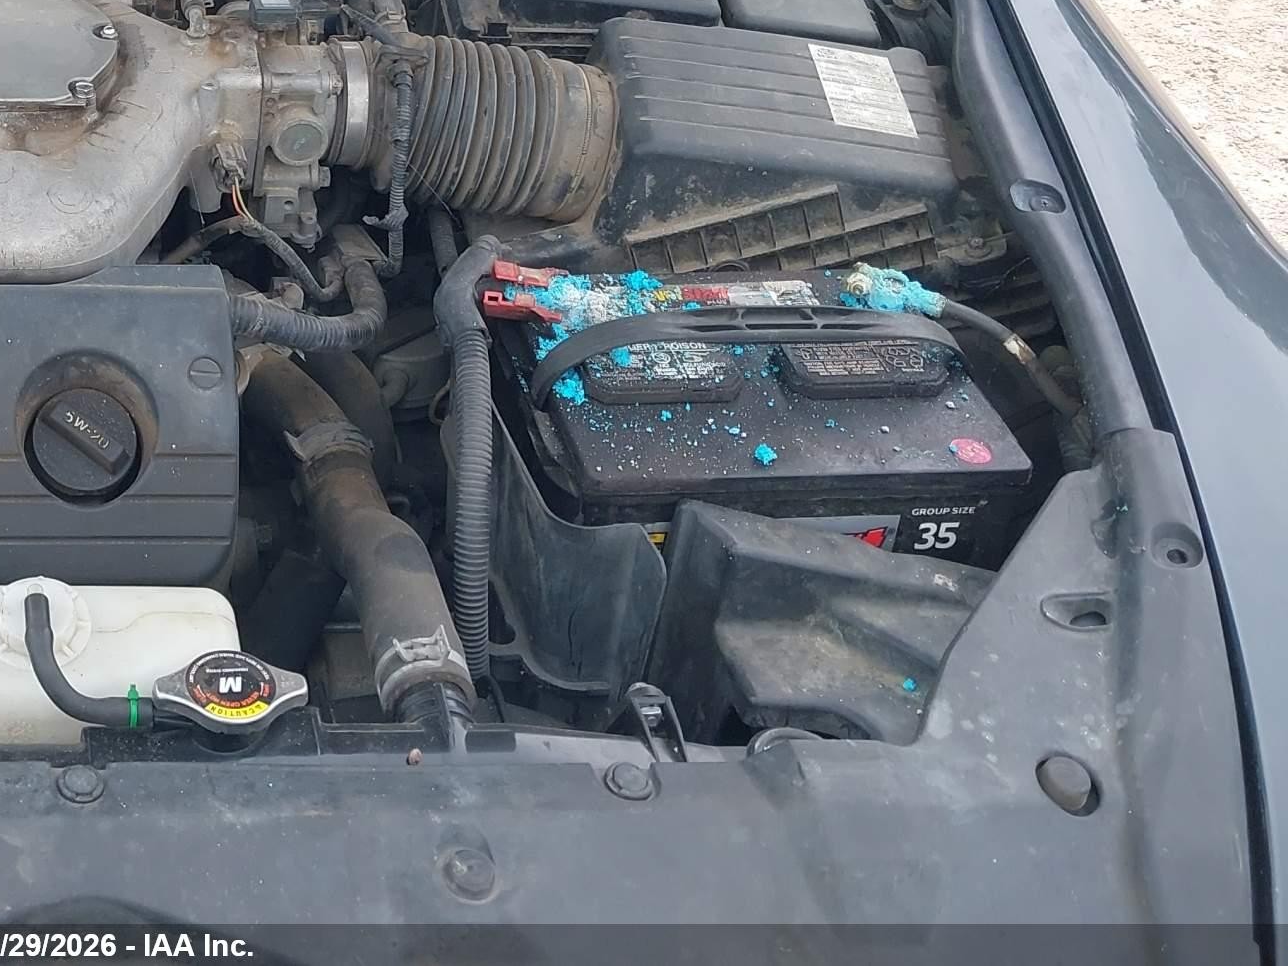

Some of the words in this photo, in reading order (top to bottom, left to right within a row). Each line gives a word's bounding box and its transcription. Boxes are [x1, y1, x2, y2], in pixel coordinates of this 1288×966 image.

[663, 341, 707, 351] POISON
[911, 506, 951, 517] GROUP
[951, 505, 977, 516] SIZE
[913, 521, 961, 551] 35
[209, 704, 258, 717] CAUTION
